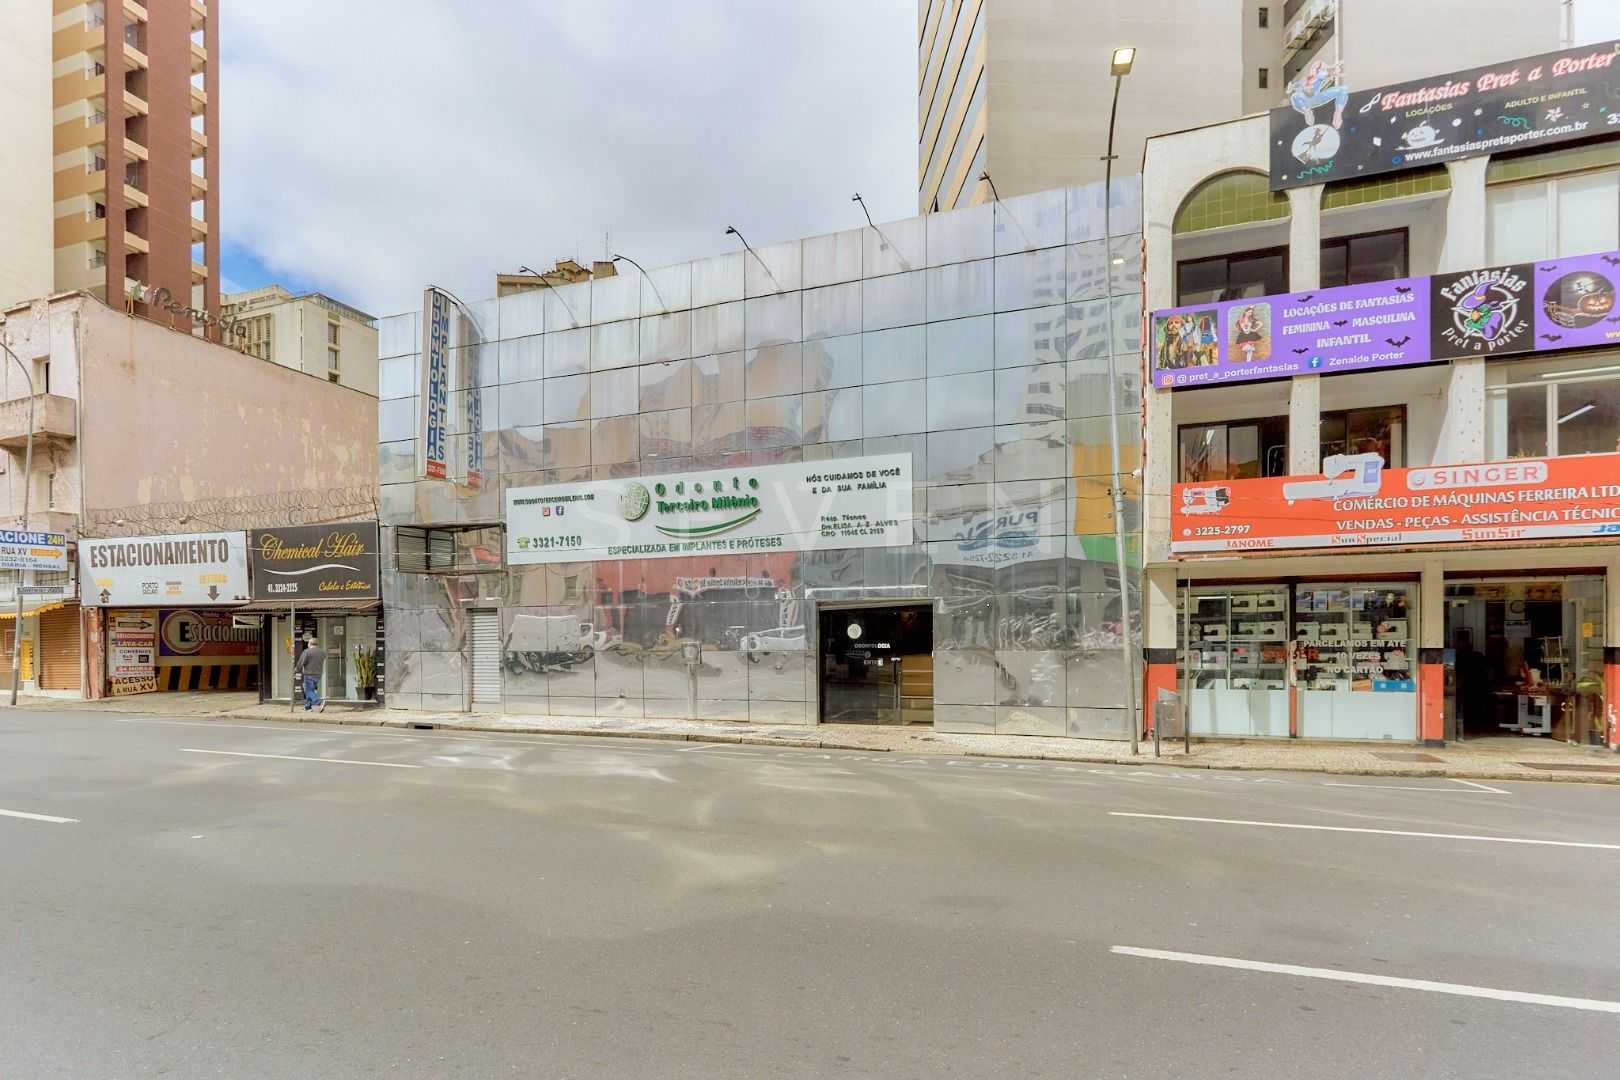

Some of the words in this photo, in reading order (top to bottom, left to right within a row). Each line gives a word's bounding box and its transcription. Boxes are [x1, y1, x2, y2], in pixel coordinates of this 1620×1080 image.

[1381, 80, 1470, 112] Fantasias
[1476, 69, 1521, 94] Pret
[1527, 66, 1544, 82] a
[1551, 52, 1617, 78] Porter
[1504, 97, 1539, 109] ADULTO
[1540, 95, 1547, 103] E
[1548, 88, 1588, 101] INFANTIL
[1405, 103, 1454, 118] LOCAÇÕES
[1404, 121, 1589, 162] www.fantasiaspretaporter.com.br
[1440, 267, 1528, 302] Fantasias
[1283, 302, 1337, 318] LOCAÇÕES
[1340, 300, 1354, 311] DE
[1355, 293, 1415, 309] FANTASIAS
[1282, 321, 1331, 336] FEMININA
[1352, 311, 1416, 328] MASCULINA
[1316, 333, 1372, 349] INFANTIL
[1372, 351, 1405, 361] Porter
[427, 292, 440, 460] ODONTOLOGIA
[437, 300, 449, 461] IMPLANTES
[806, 474, 821, 483] NÓS
[824, 472, 863, 481] CUIDAMOS
[879, 467, 900, 477] VOCÊ
[1433, 466, 1538, 486] SINGER
[858, 480, 886, 490] FAMÍLIA
[656, 499, 709, 514] Terceiro
[1334, 496, 1408, 512] COMÉRCIO
[1411, 496, 1430, 508] DE
[1433, 491, 1515, 508] MÁQUINAS
[1518, 487, 1588, 502] FERREIRA
[1337, 518, 1394, 530] VENDAS
[1405, 515, 1450, 529] PEÇAS
[1461, 508, 1559, 525] ASSISTÊNCIA
[1195, 525, 1250, 536] 3225-2797
[48, 535, 64, 544] 24H
[260, 533, 323, 560] Chemical
[324, 531, 365, 558] Hair
[532, 536, 582, 549] 3321-7150
[608, 544, 667, 555] ESPECIALIZADA
[669, 543, 681, 552] EM
[683, 539, 727, 551] IMPLANTES
[729, 540, 735, 549] E
[737, 536, 782, 549] PRÓTESES
[1227, 539, 1275, 549] JANOME
[18, 547, 27, 555] XV
[90, 539, 229, 568] ESTACIONAMENTO
[1303, 640, 1367, 648] PARCELAMOS
[1370, 640, 1385, 648] EM
[1350, 652, 1380, 660] VEZES
[1327, 666, 1341, 674] NO
[115, 676, 154, 685] ACESSO
[140, 682, 154, 690] XV
